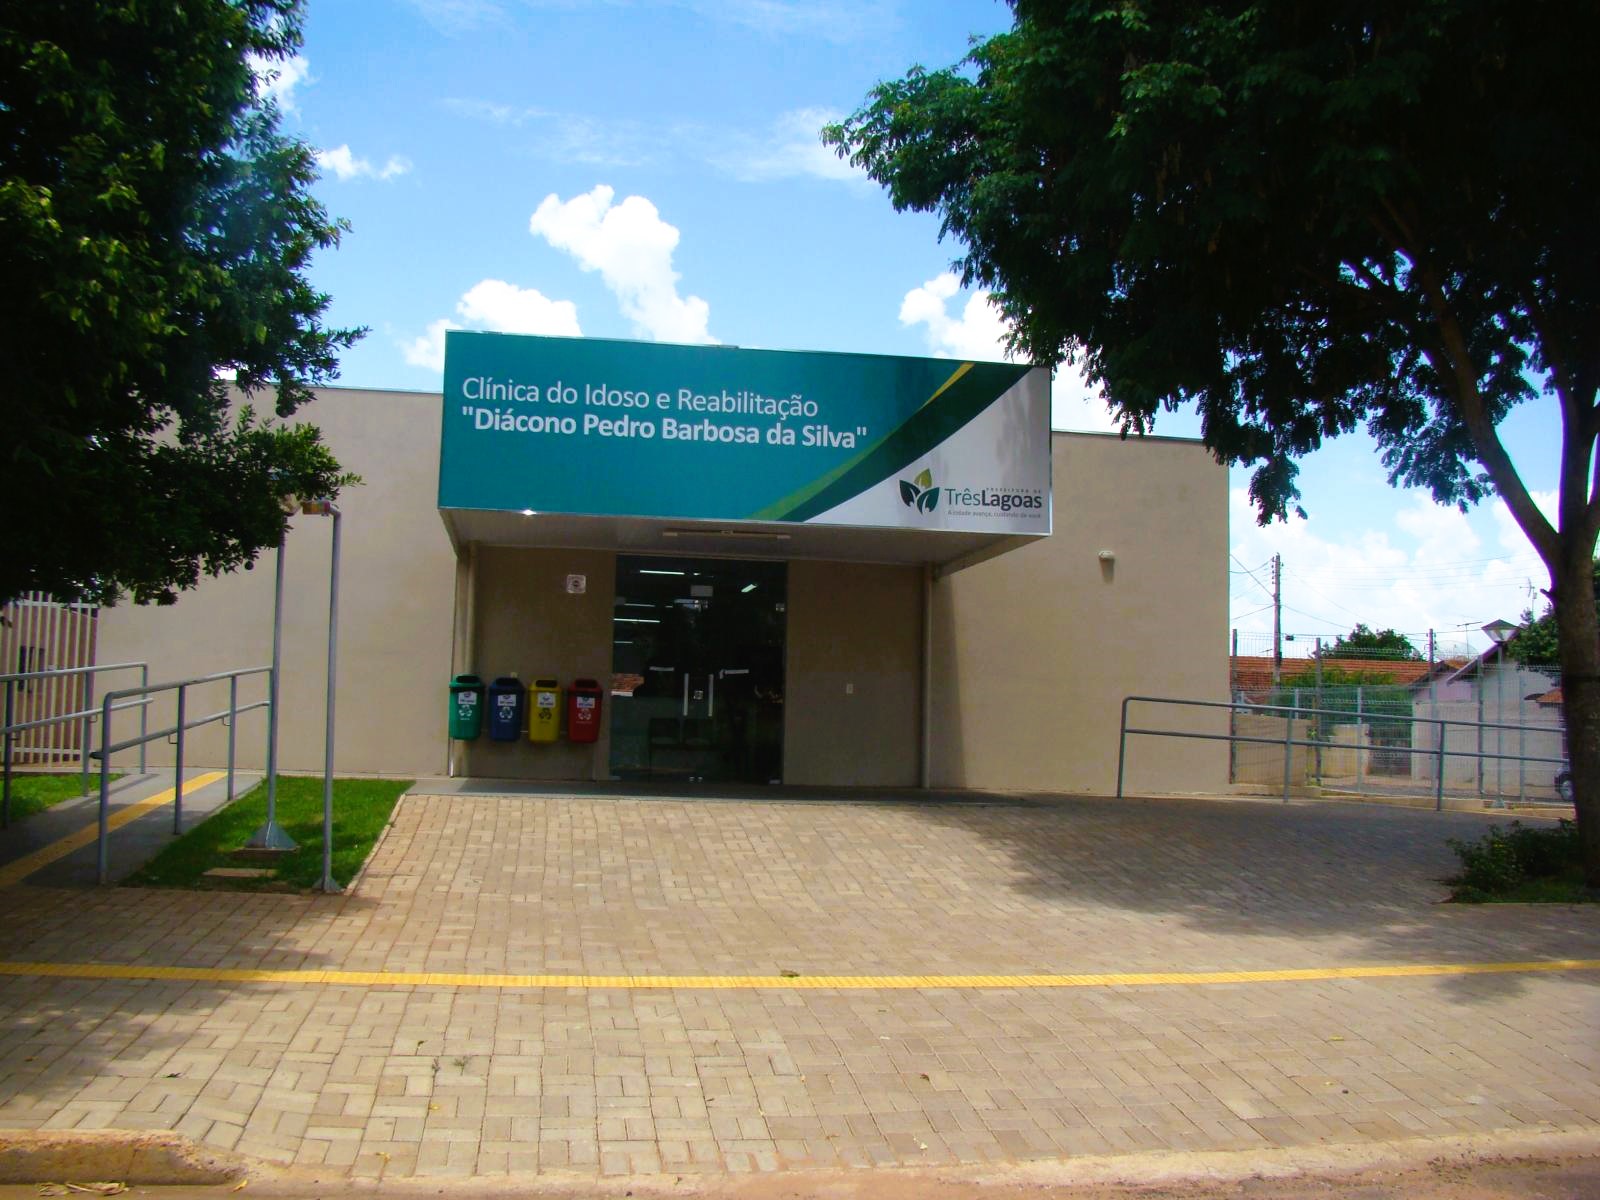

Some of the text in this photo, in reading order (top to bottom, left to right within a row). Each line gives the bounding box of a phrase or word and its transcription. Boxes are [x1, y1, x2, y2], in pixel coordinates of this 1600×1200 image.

[462, 377, 819, 421] Clínica do Idoso e Reabilitação
[462, 406, 867, 449] "Diácono Pedro Barbosa da Silva"
